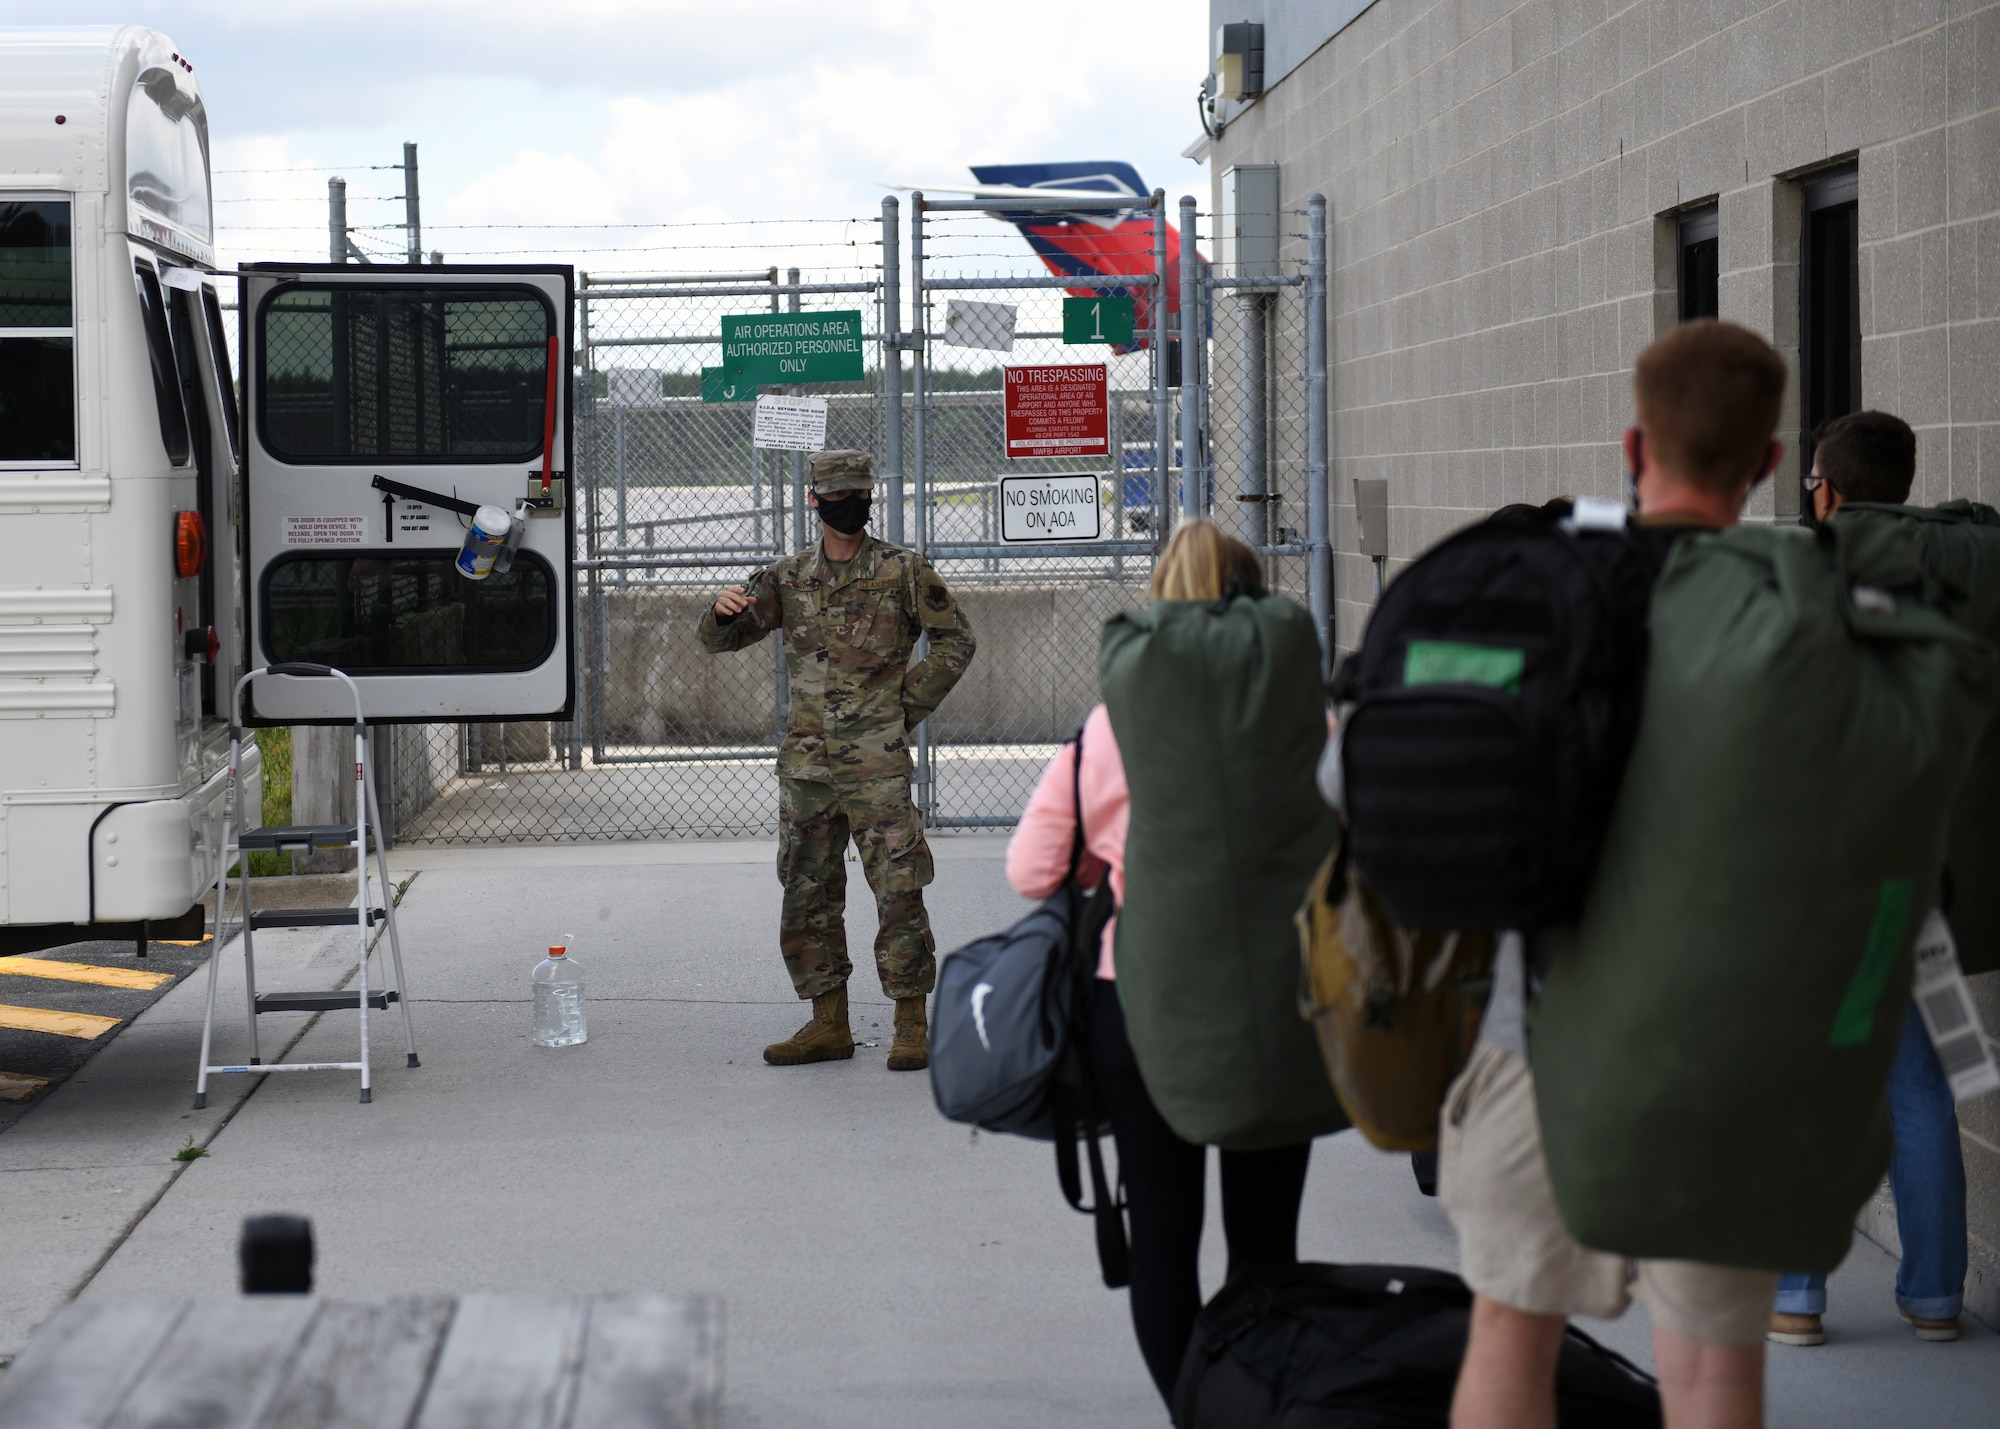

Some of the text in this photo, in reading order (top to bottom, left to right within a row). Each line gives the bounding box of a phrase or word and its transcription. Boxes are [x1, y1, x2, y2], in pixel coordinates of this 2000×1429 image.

[1091, 302, 1104, 339] 1
[734, 322, 850, 338] AIR OPERATIONS AREA
[727, 339, 859, 356] AUTHORIZED PERSONNEL
[780, 359, 807, 372] ONLY
[1008, 368, 1103, 383] NO TRESPASSING
[1061, 383, 1096, 391] DESIGNATED
[774, 397, 811, 407] STOP!!
[1019, 393, 1058, 401] OPERATIONAL
[1060, 392, 1075, 400] AREA
[1017, 401, 1042, 409] AIRPORT
[1057, 400, 1080, 408] ANYONE
[1082, 400, 1096, 408] WHO
[1007, 488, 1093, 506] NO SMOKING
[1027, 511, 1075, 528] ON AOA
